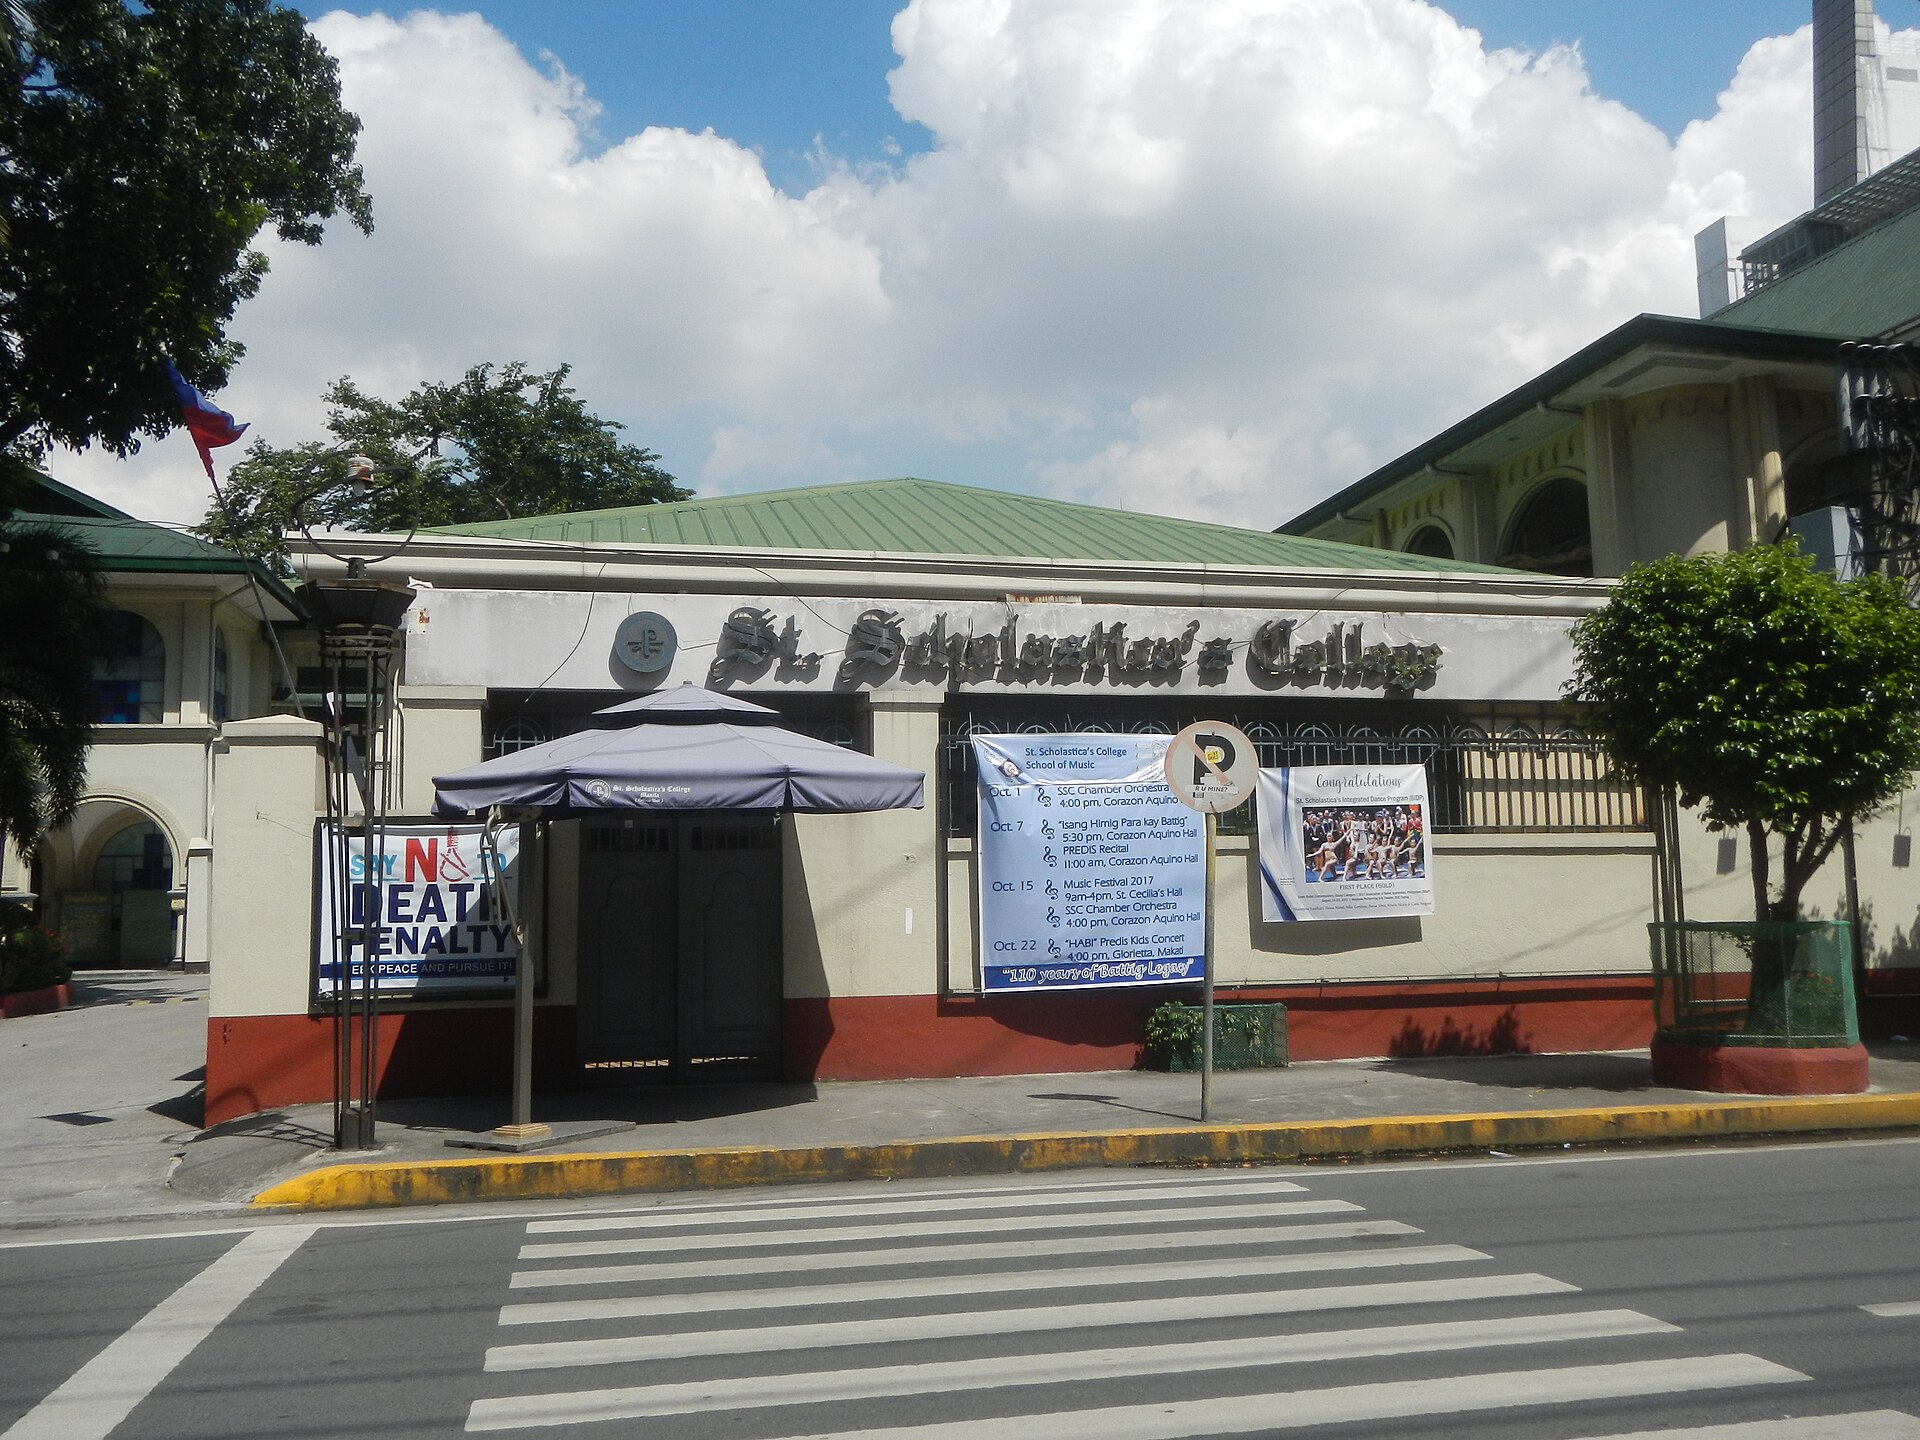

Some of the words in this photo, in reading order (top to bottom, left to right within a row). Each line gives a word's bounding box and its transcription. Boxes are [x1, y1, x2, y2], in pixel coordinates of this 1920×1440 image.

[1025, 748, 1037, 756] St.
[1039, 747, 1094, 756] Scholastica's
[1096, 747, 1127, 757] College
[1026, 760, 1054, 769] School
[1056, 760, 1067, 769] of
[1069, 760, 1095, 769] Music
[1316, 772, 1401, 793] Congratulations
[990, 787, 1011, 797] Oct.
[1017, 787, 1020, 796] 1
[1057, 787, 1075, 796] SSC
[1078, 785, 1122, 795] Chamber
[1124, 784, 1170, 793] Orchestra
[1060, 799, 1080, 808] 4:00
[1083, 799, 1102, 809] pm,
[1104, 797, 1144, 806] Corazon
[1145, 796, 1178, 806] Aquino
[991, 822, 1012, 832] Oct.
[1017, 822, 1023, 831] 7
[1090, 819, 1118, 829] Himig
[1121, 818, 1141, 827] Para
[1144, 818, 1159, 828] kay
[1062, 833, 1083, 842] 5:30
[1086, 834, 1104, 843] pm,
[1107, 831, 1146, 840] Corazon
[1148, 830, 1180, 841] Aquino
[1183, 829, 1197, 838] Hall
[1063, 845, 1096, 855] PREDIS
[1100, 844, 1128, 853] Recital
[350, 854, 398, 876] SAY
[1064, 860, 1085, 869] 11:00
[1088, 860, 1106, 868] am,
[1108, 857, 1148, 866] Corazon
[1150, 855, 1182, 866] Aquino
[1185, 854, 1199, 862] Hall
[992, 881, 1015, 891] Oct.
[1021, 881, 1033, 891] 15
[1064, 880, 1091, 888] Music
[1094, 878, 1128, 887] Festival
[1131, 876, 1154, 885] 2017
[1129, 889, 1164, 899] Cecilia's
[1167, 888, 1182, 896] Hall
[1065, 906, 1083, 915] SSC
[1086, 904, 1130, 914] Chamber
[1133, 902, 1177, 911] Orchestra
[1066, 919, 1088, 928] 4:00
[1090, 920, 1108, 929] pm,
[1111, 916, 1150, 926] Corazon
[1153, 914, 1185, 925] Aquino
[1186, 912, 1200, 921] Hall
[994, 940, 1016, 951] Oct.
[1021, 940, 1036, 950] 22
[1100, 937, 1128, 946] Predis
[1130, 935, 1150, 945] Kids
[1151, 934, 1184, 943] Concert
[1068, 952, 1089, 961] 4:00
[1112, 949, 1154, 959] Glorietta,
[1158, 946, 1183, 956] Makati
[345, 964, 375, 974] EEK
[378, 964, 418, 974] PEACE
[421, 963, 444, 972] AND
[448, 962, 495, 972] PURSUE
[498, 962, 512, 970] IT!
[1038, 966, 1081, 984] years
[1082, 963, 1098, 980] of
[1100, 964, 1147, 980] Battig
